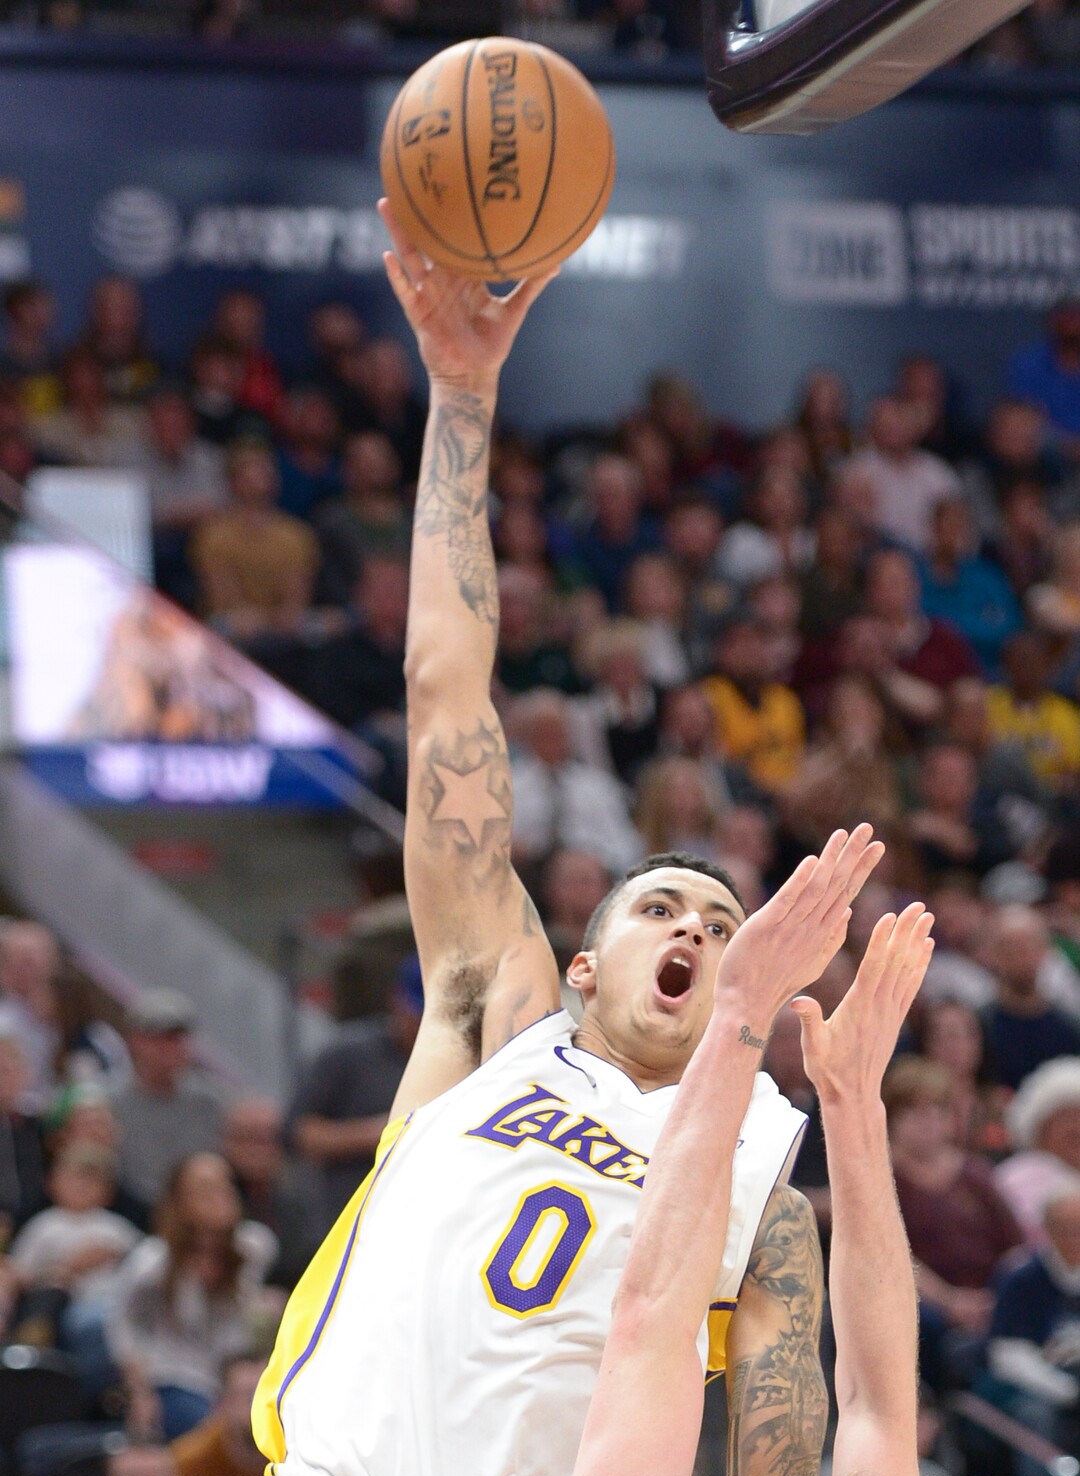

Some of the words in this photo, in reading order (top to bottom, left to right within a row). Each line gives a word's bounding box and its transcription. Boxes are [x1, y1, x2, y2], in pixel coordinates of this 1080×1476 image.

[481, 51, 521, 206] SPALDING
[460, 1081, 651, 1191] LAKE
[480, 1180, 597, 1320] 0
